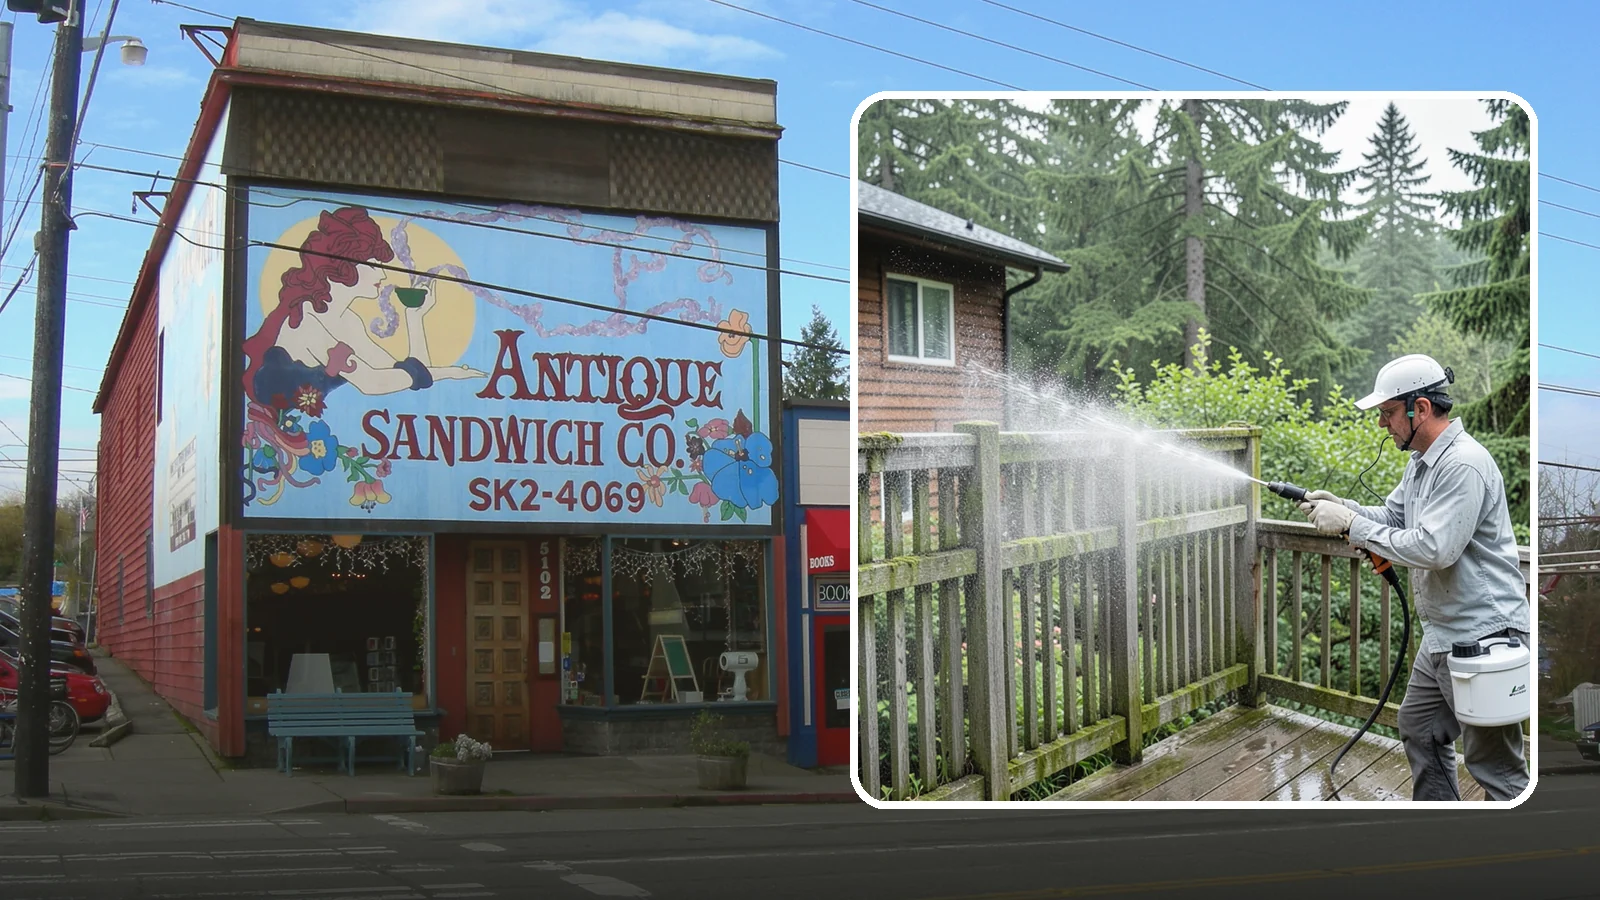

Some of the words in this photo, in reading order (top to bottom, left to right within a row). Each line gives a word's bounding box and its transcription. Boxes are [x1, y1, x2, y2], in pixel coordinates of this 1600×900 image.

[476, 329, 723, 420] ANTIQUE
[361, 408, 604, 467] SANDWICH
[616, 421, 686, 470] CO.
[468, 477, 646, 514] SK2-4069
[539, 541, 552, 600] 5102
[809, 555, 834, 569] BOOKS
